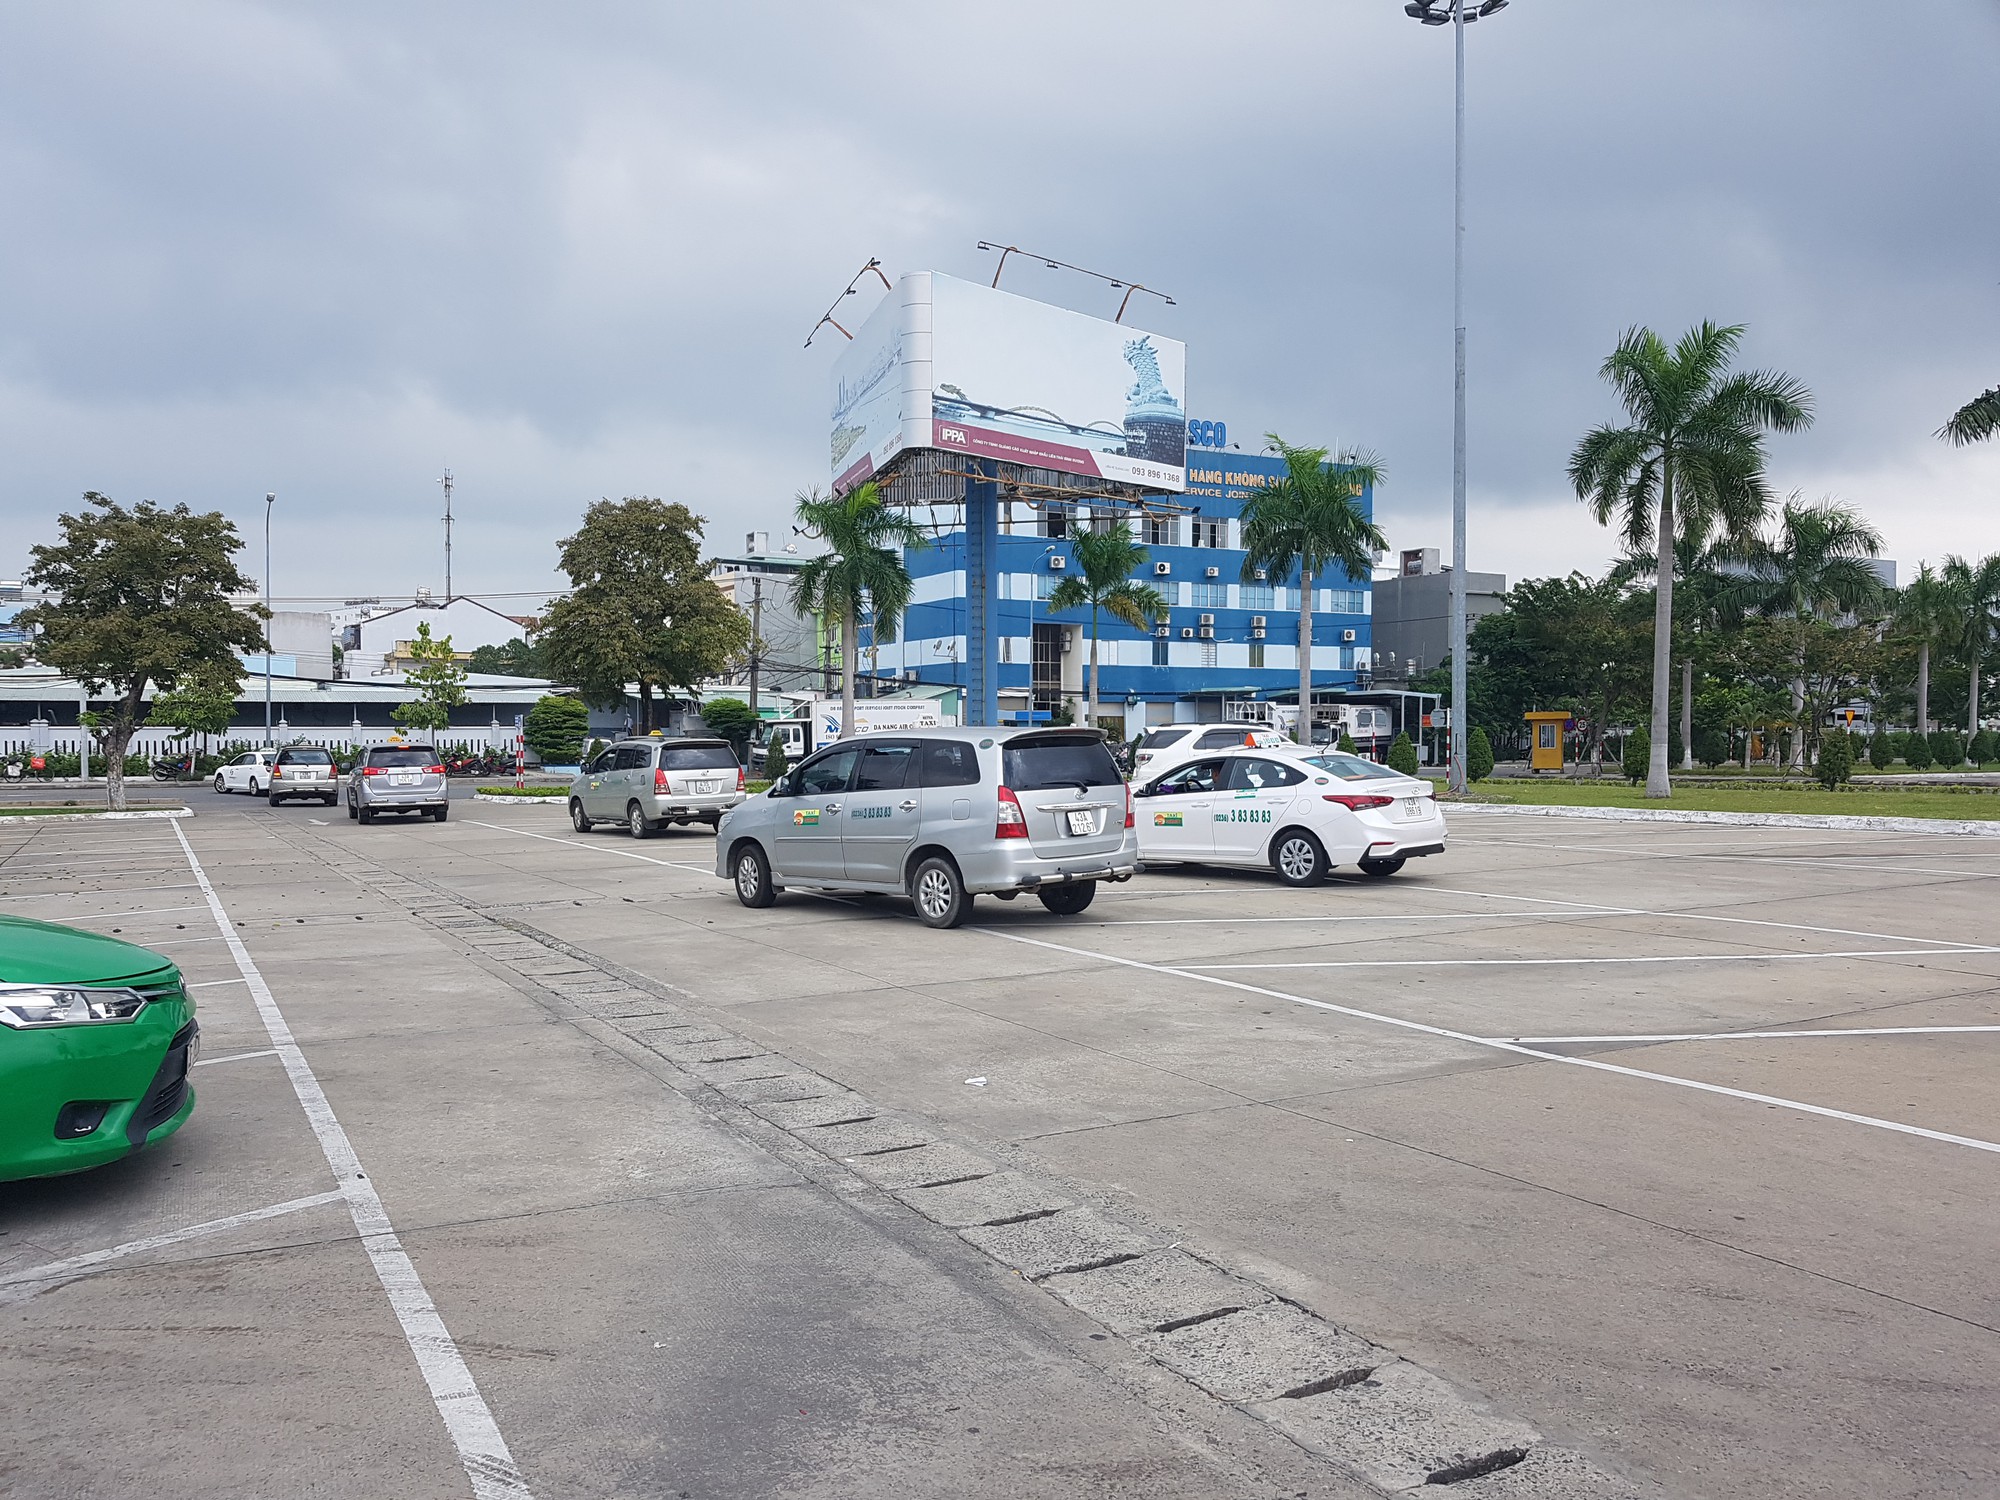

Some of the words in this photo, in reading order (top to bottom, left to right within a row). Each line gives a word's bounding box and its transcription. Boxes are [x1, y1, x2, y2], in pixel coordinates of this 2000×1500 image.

[942, 428, 966, 444] IPPA
[1188, 419, 1227, 448] SCO
[1131, 466, 1146, 477] 093
[1147, 468, 1161, 479] 896
[1163, 472, 1180, 483] 1368
[1189, 467, 1222, 485] HÀNG
[1225, 470, 1266, 488] KHÔNG
[1184, 486, 1222, 498] ERVICE
[824, 724, 869, 734] MCO
[863, 808, 868, 819] 3
[868, 807, 875, 818] 83
[876, 807, 883, 818] 83
[884, 806, 891, 817] 83
[1074, 811, 1088, 822] 43A
[1231, 809, 1236, 822] 3
[1238, 809, 1247, 823] 83
[1249, 809, 1259, 823] 83
[1261, 810, 1271, 823] 83
[1072, 821, 1096, 834] 21267
